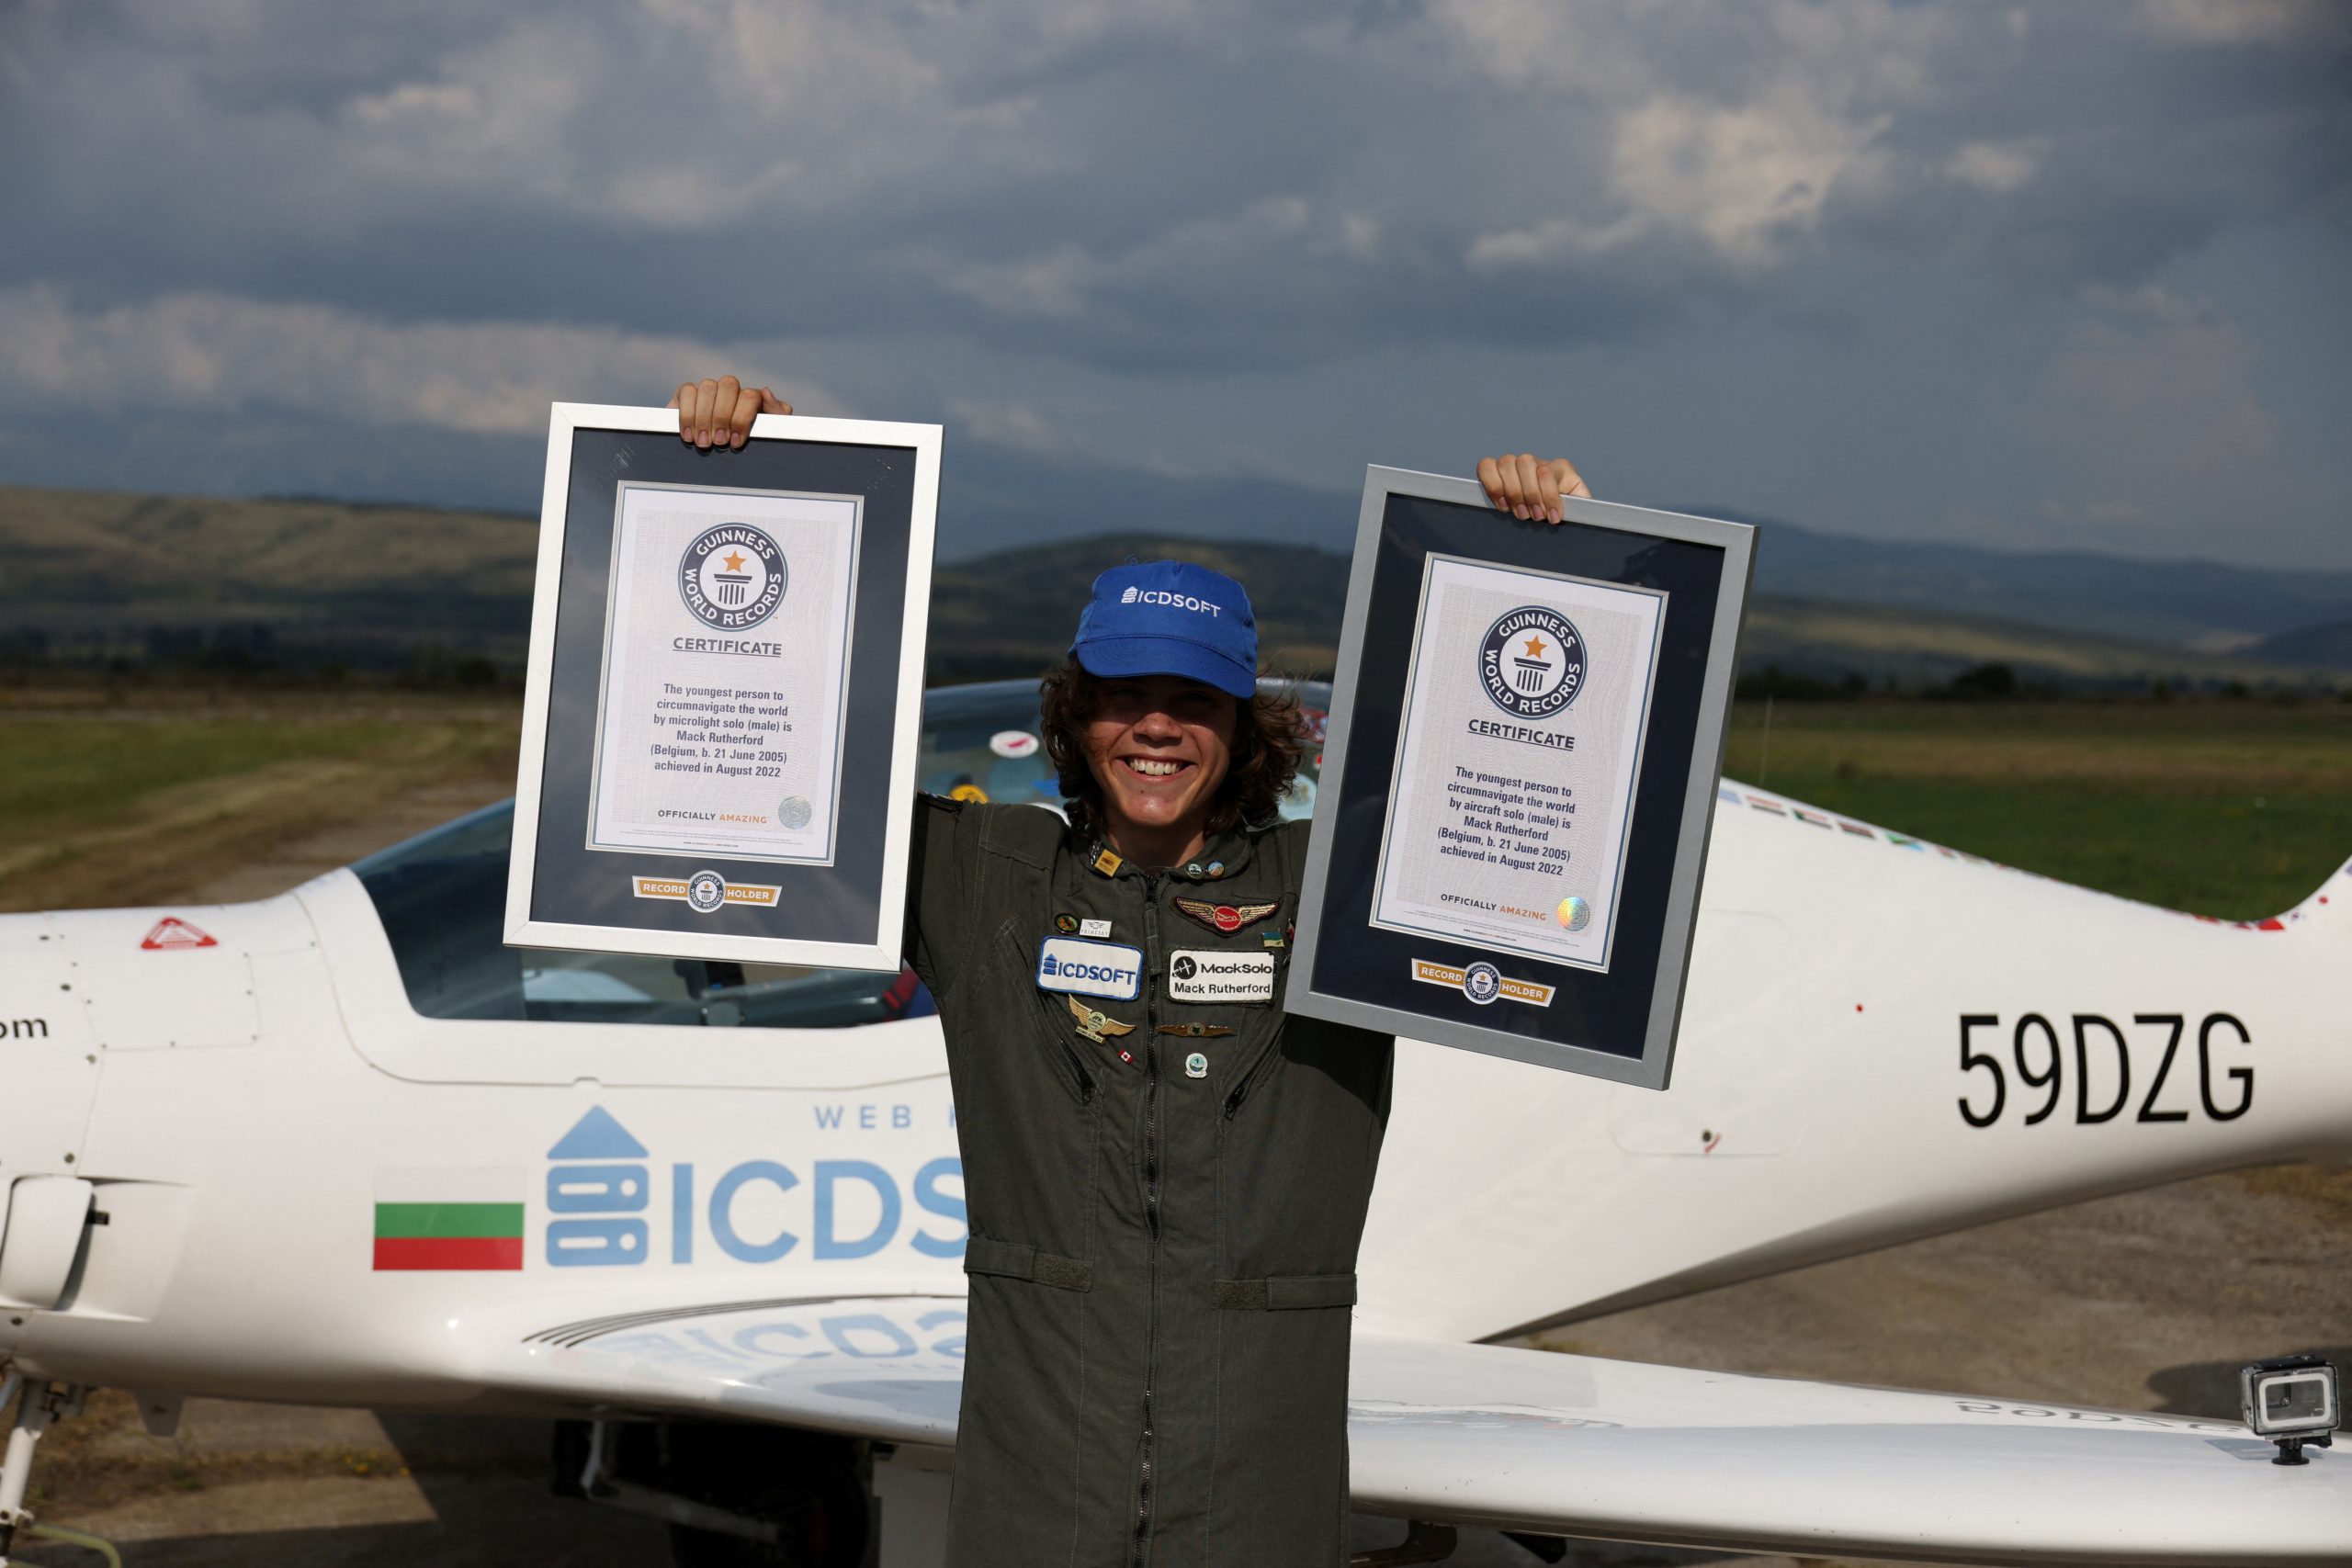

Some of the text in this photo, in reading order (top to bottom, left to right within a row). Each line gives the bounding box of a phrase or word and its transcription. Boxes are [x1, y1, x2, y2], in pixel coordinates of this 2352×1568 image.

[695, 529, 775, 559] GUINNESS
[684, 568, 782, 626] WORLD RECORDS
[1137, 590, 1221, 617] ICDSOFT
[1498, 613, 1576, 649] GUINNESS
[673, 637, 782, 656] CERTIFICATE
[663, 682, 784, 701] The youngest person to
[1485, 649, 1581, 713] WORLD RECORDS
[656, 698, 788, 716] circumnavigate the world
[653, 713, 792, 733] by microlight solo (male) is
[1468, 718, 1576, 750] CERTIFICATE
[676, 729, 763, 746] Mack Rutherford
[650, 743, 787, 764] (Belgium, b. 21 June 2005)
[653, 760, 781, 778] achieved in August 2022
[1455, 765, 1572, 797] The youngest person to
[1446, 781, 1576, 815] circumnavigate the world
[657, 809, 767, 824] OFFICIALLY AMAZING
[1448, 795, 1571, 829] by aircraft solo (male) is
[1463, 815, 1549, 841] Mack Rutherford
[1437, 826, 1571, 863] (Belgium, b. 21 June 2005)
[1440, 844, 1564, 876] achieved in August 2022
[643, 883, 770, 899] RECORD HOLDER
[694, 875, 720, 886] GUINNESS
[690, 887, 723, 908] WORLD RECORDS
[1440, 893, 1545, 920] OFFICIALLY AMAZING
[1058, 963, 1136, 986] ICDSOFT
[1201, 963, 1272, 975] MackSolo
[1471, 966, 1497, 978] GUINNESS
[1175, 982, 1271, 994] Mack Rutherford
[1421, 966, 1544, 998] RECORD HOLDER
[1466, 977, 1498, 998] WORLD RECORDS
[1958, 1011, 2254, 1128] 59DZG
[815, 1105, 912, 1130] WEB
